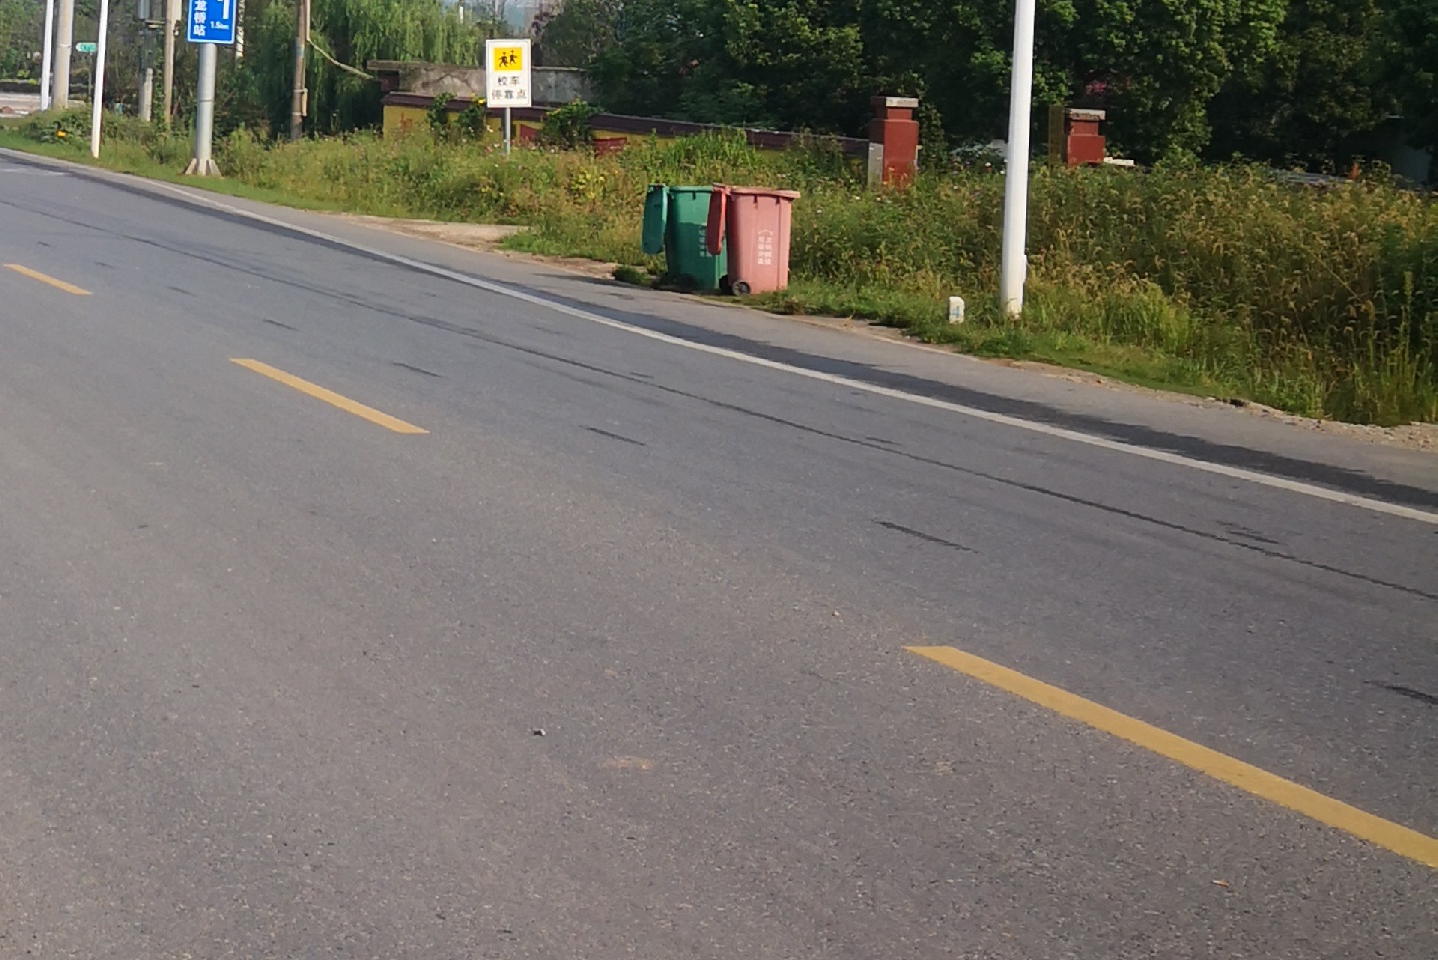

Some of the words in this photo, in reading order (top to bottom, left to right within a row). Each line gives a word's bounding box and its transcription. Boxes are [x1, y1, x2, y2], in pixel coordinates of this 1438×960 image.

[498, 76, 519, 86] 校车
[492, 89, 527, 100] 停靠点
